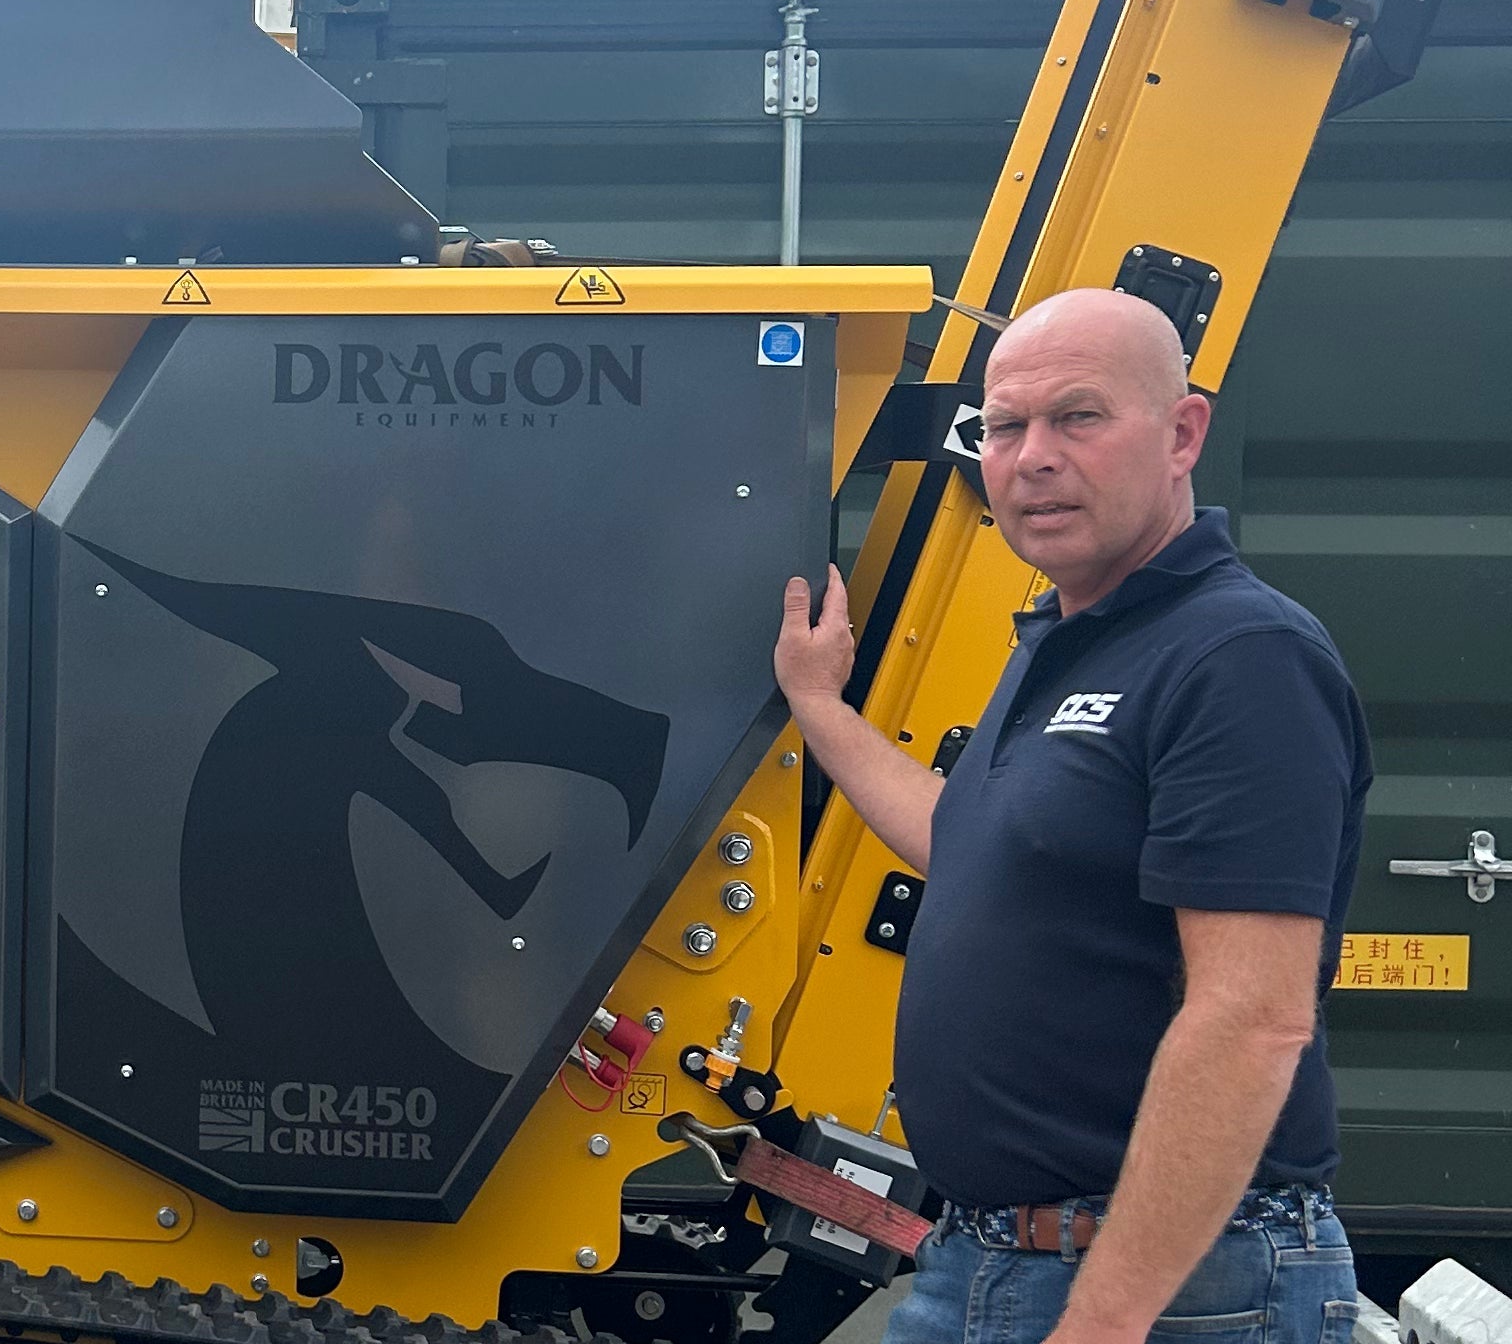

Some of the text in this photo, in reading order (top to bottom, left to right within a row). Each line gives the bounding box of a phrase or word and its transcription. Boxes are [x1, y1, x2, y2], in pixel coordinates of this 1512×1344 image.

[272, 342, 644, 407] DRAGON
[355, 412, 559, 429] EQUIPMENT
[1049, 693, 1124, 724] CCS
[199, 1079, 266, 1094] MADE IN
[199, 1093, 265, 1109] BRITAIN
[270, 1082, 437, 1128] CR450
[269, 1126, 434, 1161] CRUSHER
